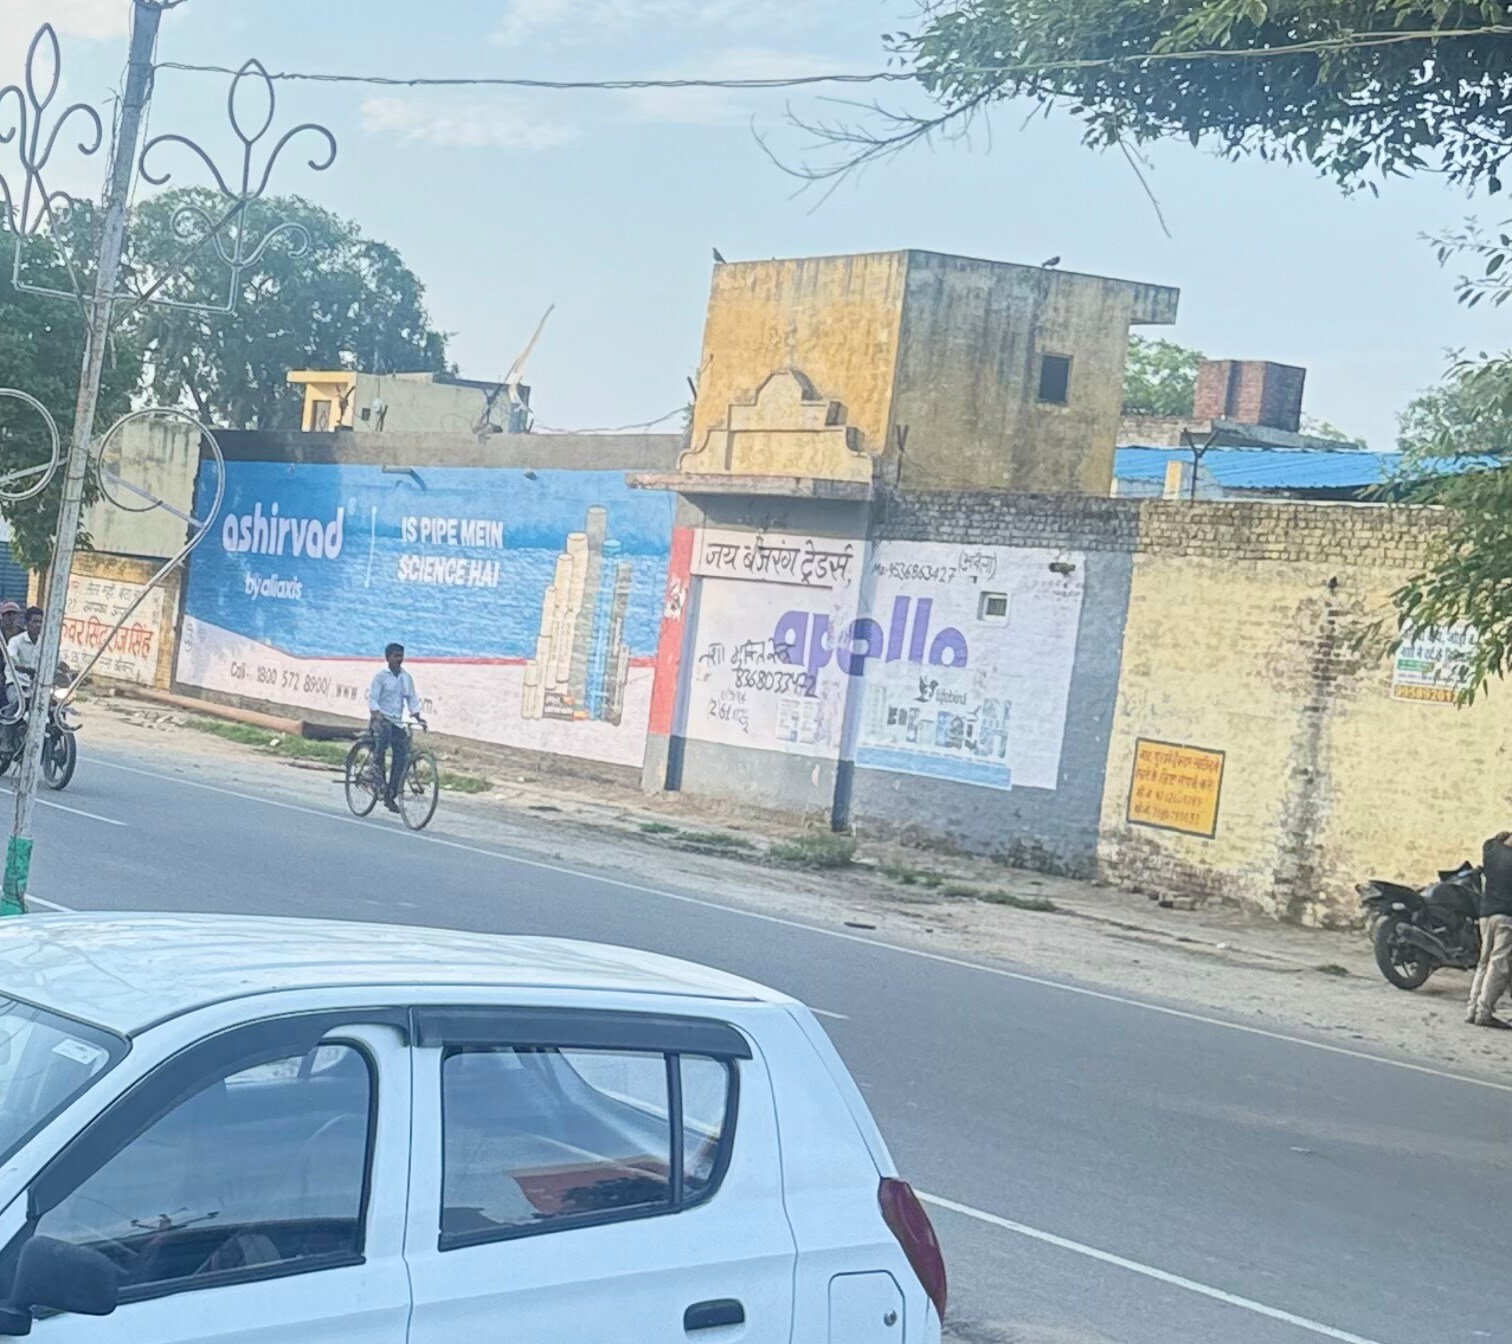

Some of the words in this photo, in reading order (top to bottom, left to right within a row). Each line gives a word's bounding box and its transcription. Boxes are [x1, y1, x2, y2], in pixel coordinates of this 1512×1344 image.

[222, 502, 345, 560] ashirvad
[402, 516, 418, 544] IS
[420, 517, 459, 546] PIPE
[460, 519, 505, 549] MEIN
[397, 554, 466, 586] SCIENCE
[467, 558, 501, 588] HAI
[706, 543, 741, 570] जय
[244, 570, 260, 601] by
[260, 572, 303, 600] aliaxis
[774, 595, 969, 677] apollo
[280, 670, 302, 691] 572
